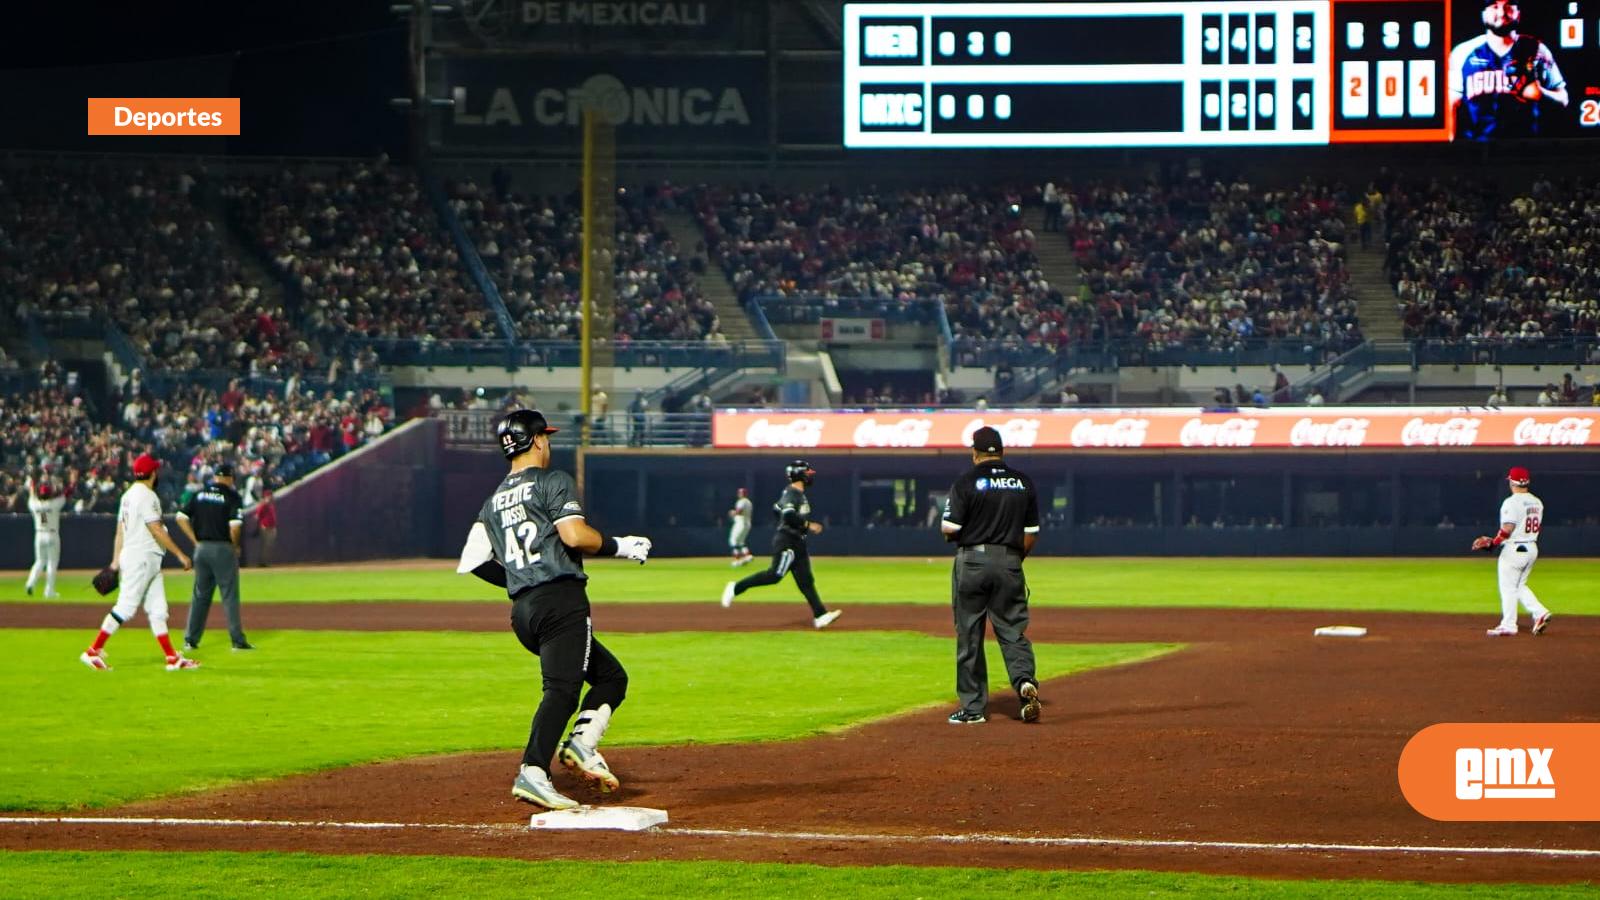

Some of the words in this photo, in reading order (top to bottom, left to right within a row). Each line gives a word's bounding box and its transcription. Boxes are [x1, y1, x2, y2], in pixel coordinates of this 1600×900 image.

[523, 1, 560, 24] DE
[567, 1, 706, 25] MEXICALI
[1350, 77, 1361, 96] 2
[1385, 77, 1396, 96] 0
[452, 87, 522, 125] LA
[862, 94, 922, 124] MXC
[990, 478, 1025, 490] MEGA
[492, 481, 536, 512] TECATE
[501, 504, 527, 528] JASSO
[1525, 516, 1540, 534] 88
[505, 521, 541, 569] 42
